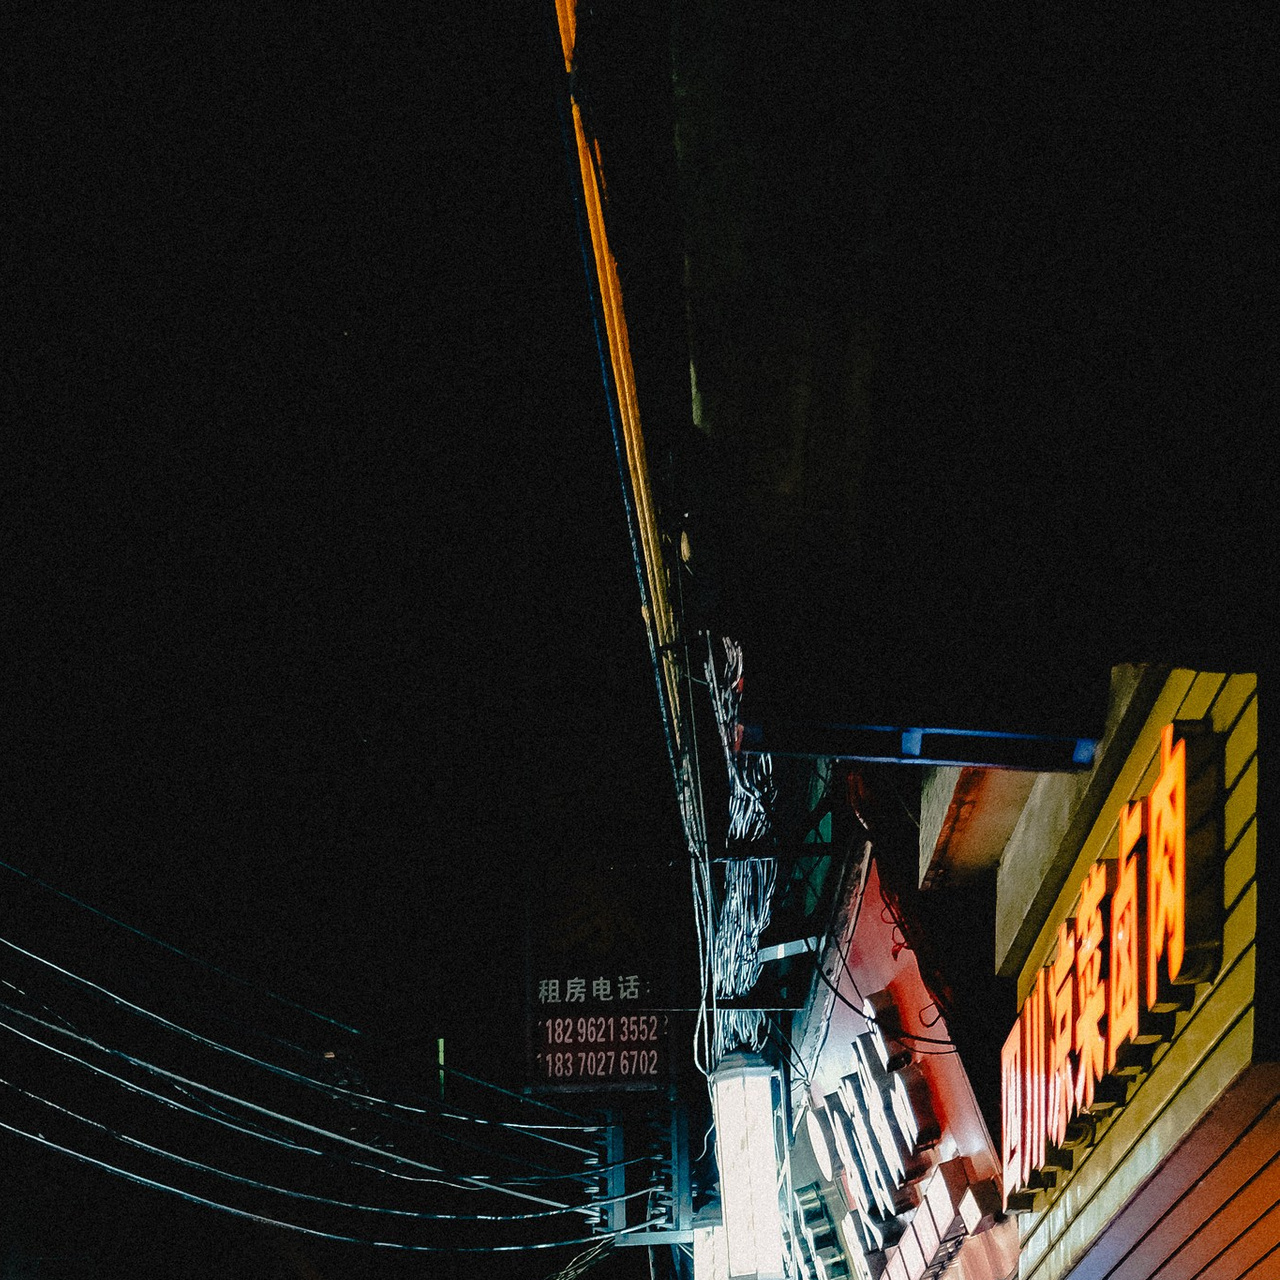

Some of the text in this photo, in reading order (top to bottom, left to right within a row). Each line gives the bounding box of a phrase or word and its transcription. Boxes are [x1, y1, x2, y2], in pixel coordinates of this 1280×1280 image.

[1002, 723, 1186, 1213] 四川凉菜卤肉
